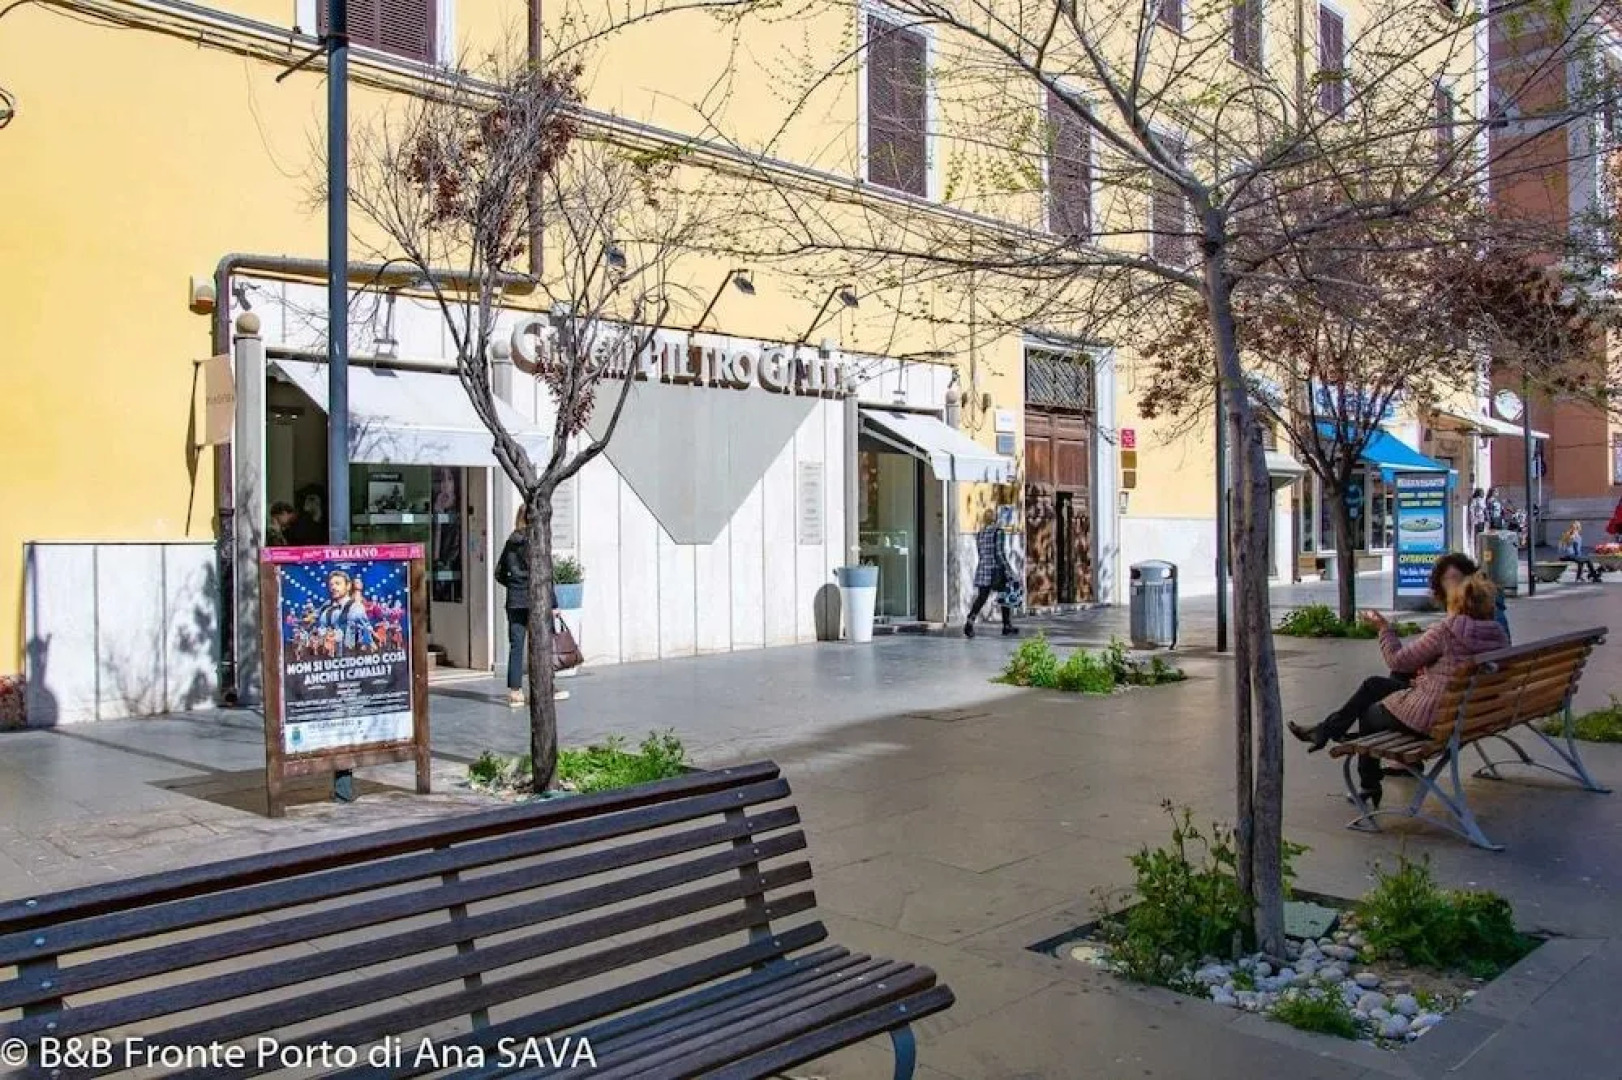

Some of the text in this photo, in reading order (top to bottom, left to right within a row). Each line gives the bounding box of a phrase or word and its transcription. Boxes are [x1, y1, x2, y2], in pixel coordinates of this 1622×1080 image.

[323, 547, 378, 559] TRAIANO
[286, 662, 312, 675] NON
[312, 660, 322, 672] SI
[324, 655, 380, 670] UCCIDONO
[304, 672, 339, 685] ANCHE
